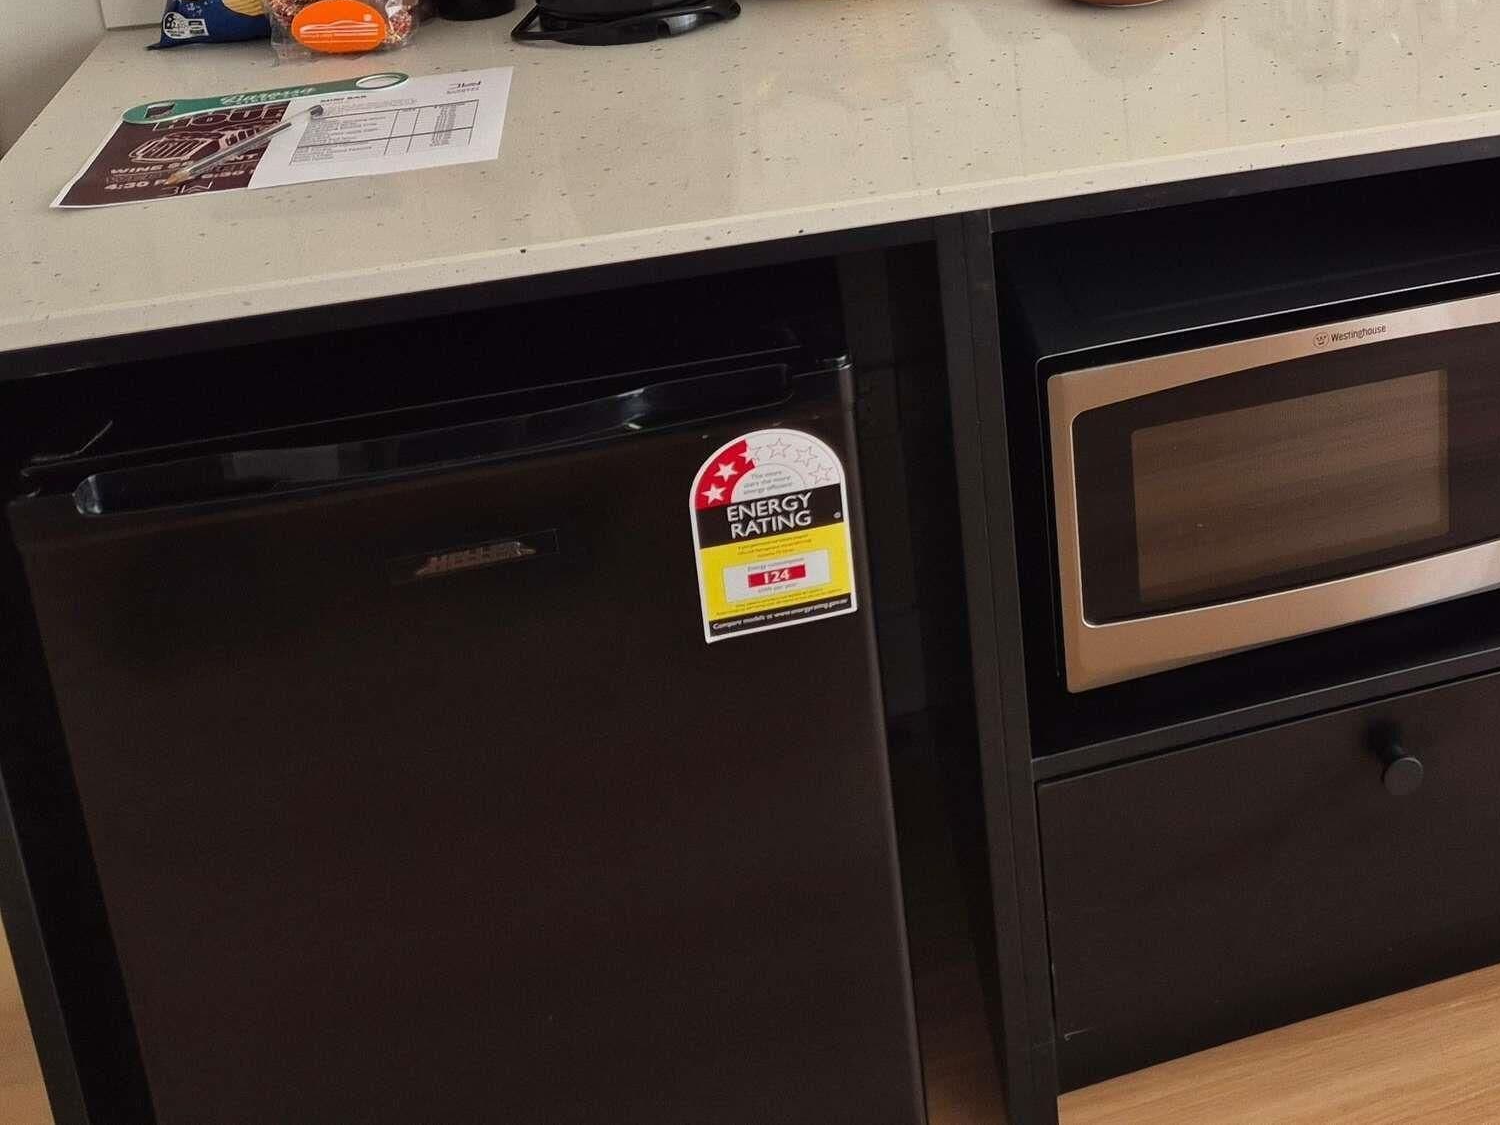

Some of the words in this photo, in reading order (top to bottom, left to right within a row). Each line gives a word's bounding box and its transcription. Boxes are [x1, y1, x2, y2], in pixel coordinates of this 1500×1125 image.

[110, 163, 163, 174] WINE
[105, 181, 150, 190] 4:30
[1331, 325, 1386, 342] Westinghouse
[726, 492, 812, 522] ENERGY
[731, 510, 812, 539] RATING
[763, 569, 790, 584] 124
